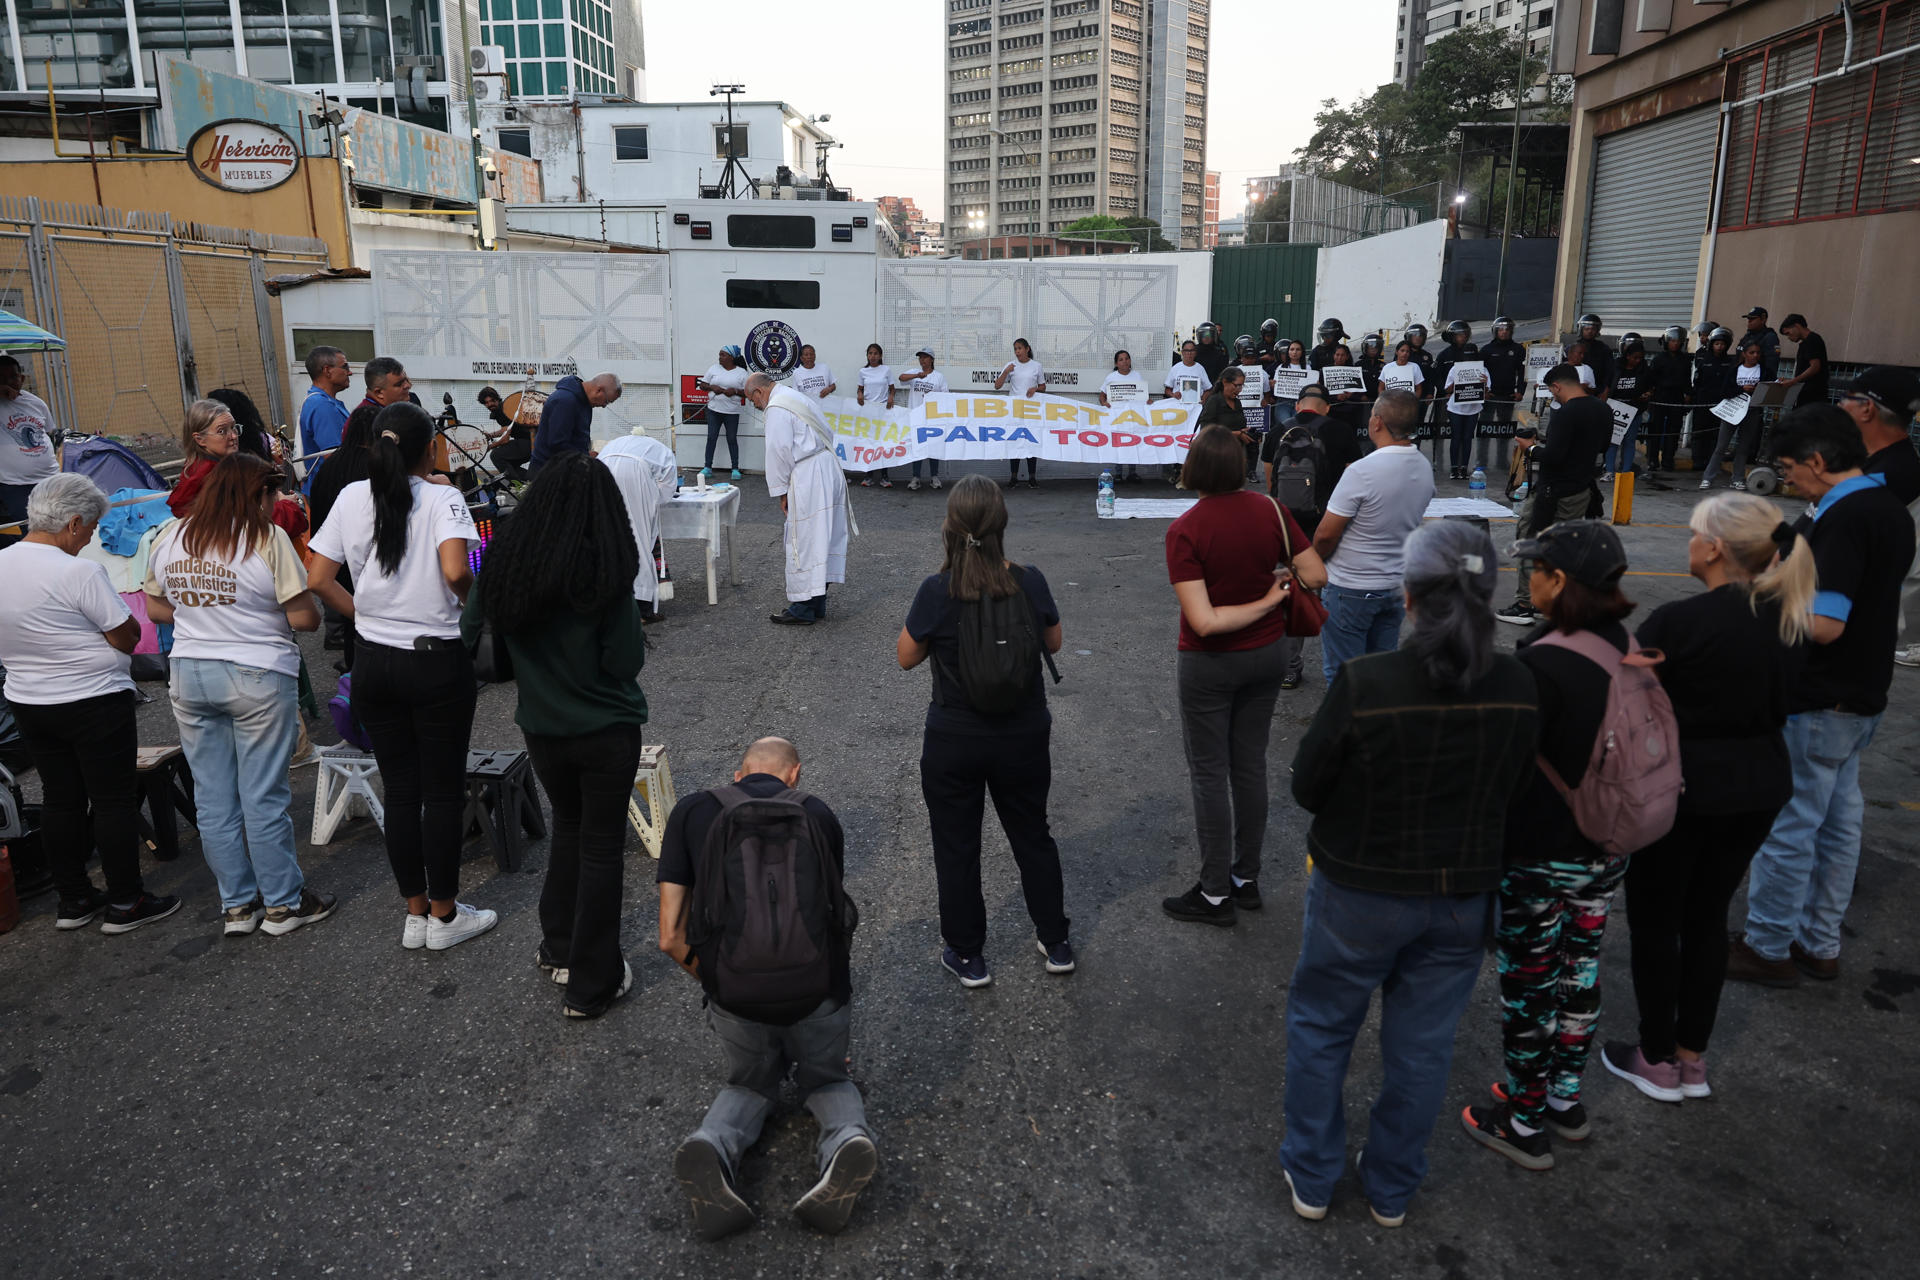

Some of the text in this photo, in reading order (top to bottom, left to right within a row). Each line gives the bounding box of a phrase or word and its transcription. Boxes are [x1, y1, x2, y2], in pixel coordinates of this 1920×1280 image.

[224, 170, 273, 180] MUEBLES
[752, 322, 768, 335] CUERPO
[778, 329, 796, 346] NACIONAL
[472, 361, 490, 374] CONTROL
[491, 362, 496, 374] DE
[497, 362, 518, 375] REUNIONES
[543, 363, 578, 376] MANIFESTACIONES
[972, 370, 990, 383] CONTROL
[991, 371, 996, 383] DE
[925, 398, 1188, 427] LIBERTAD
[917, 426, 1196, 449] PARA TODOS
[1481, 425, 1514, 434] POLICÍA
[853, 441, 907, 465] TODOS
[164, 557, 237, 580] Fundación
[170, 590, 238, 607] 2025
